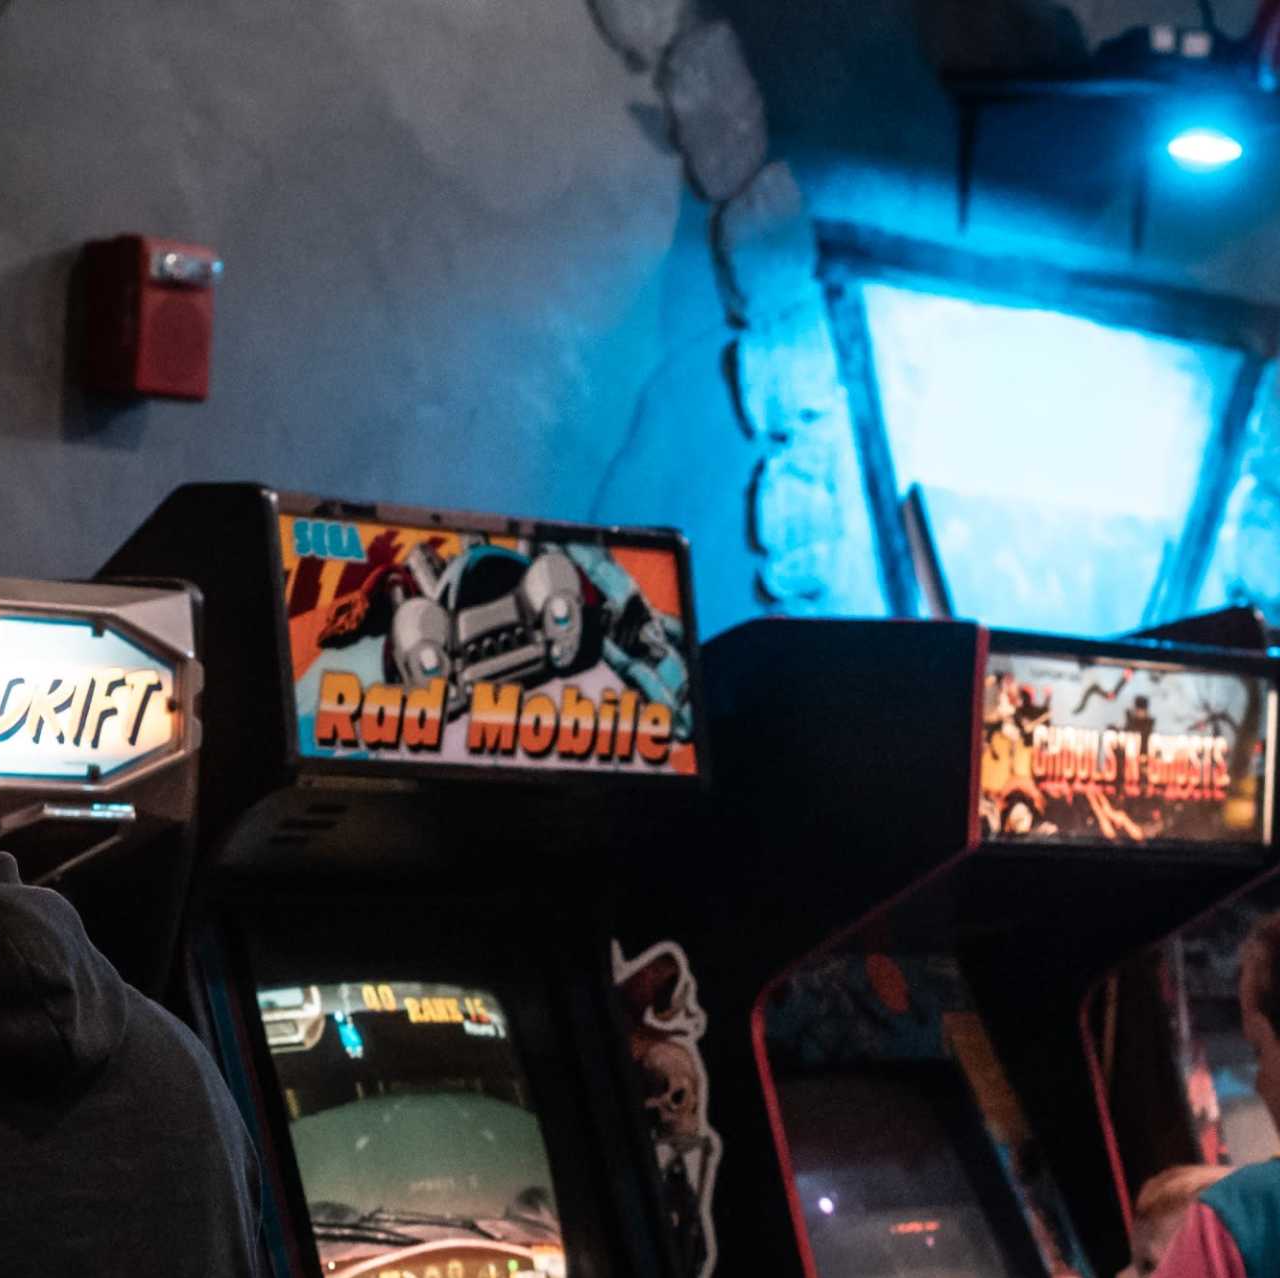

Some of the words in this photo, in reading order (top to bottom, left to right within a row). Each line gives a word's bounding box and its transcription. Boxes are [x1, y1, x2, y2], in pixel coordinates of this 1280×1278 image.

[293, 518, 367, 563] SEGA
[319, 672, 449, 753] Rad
[468, 681, 679, 762] Mobile
